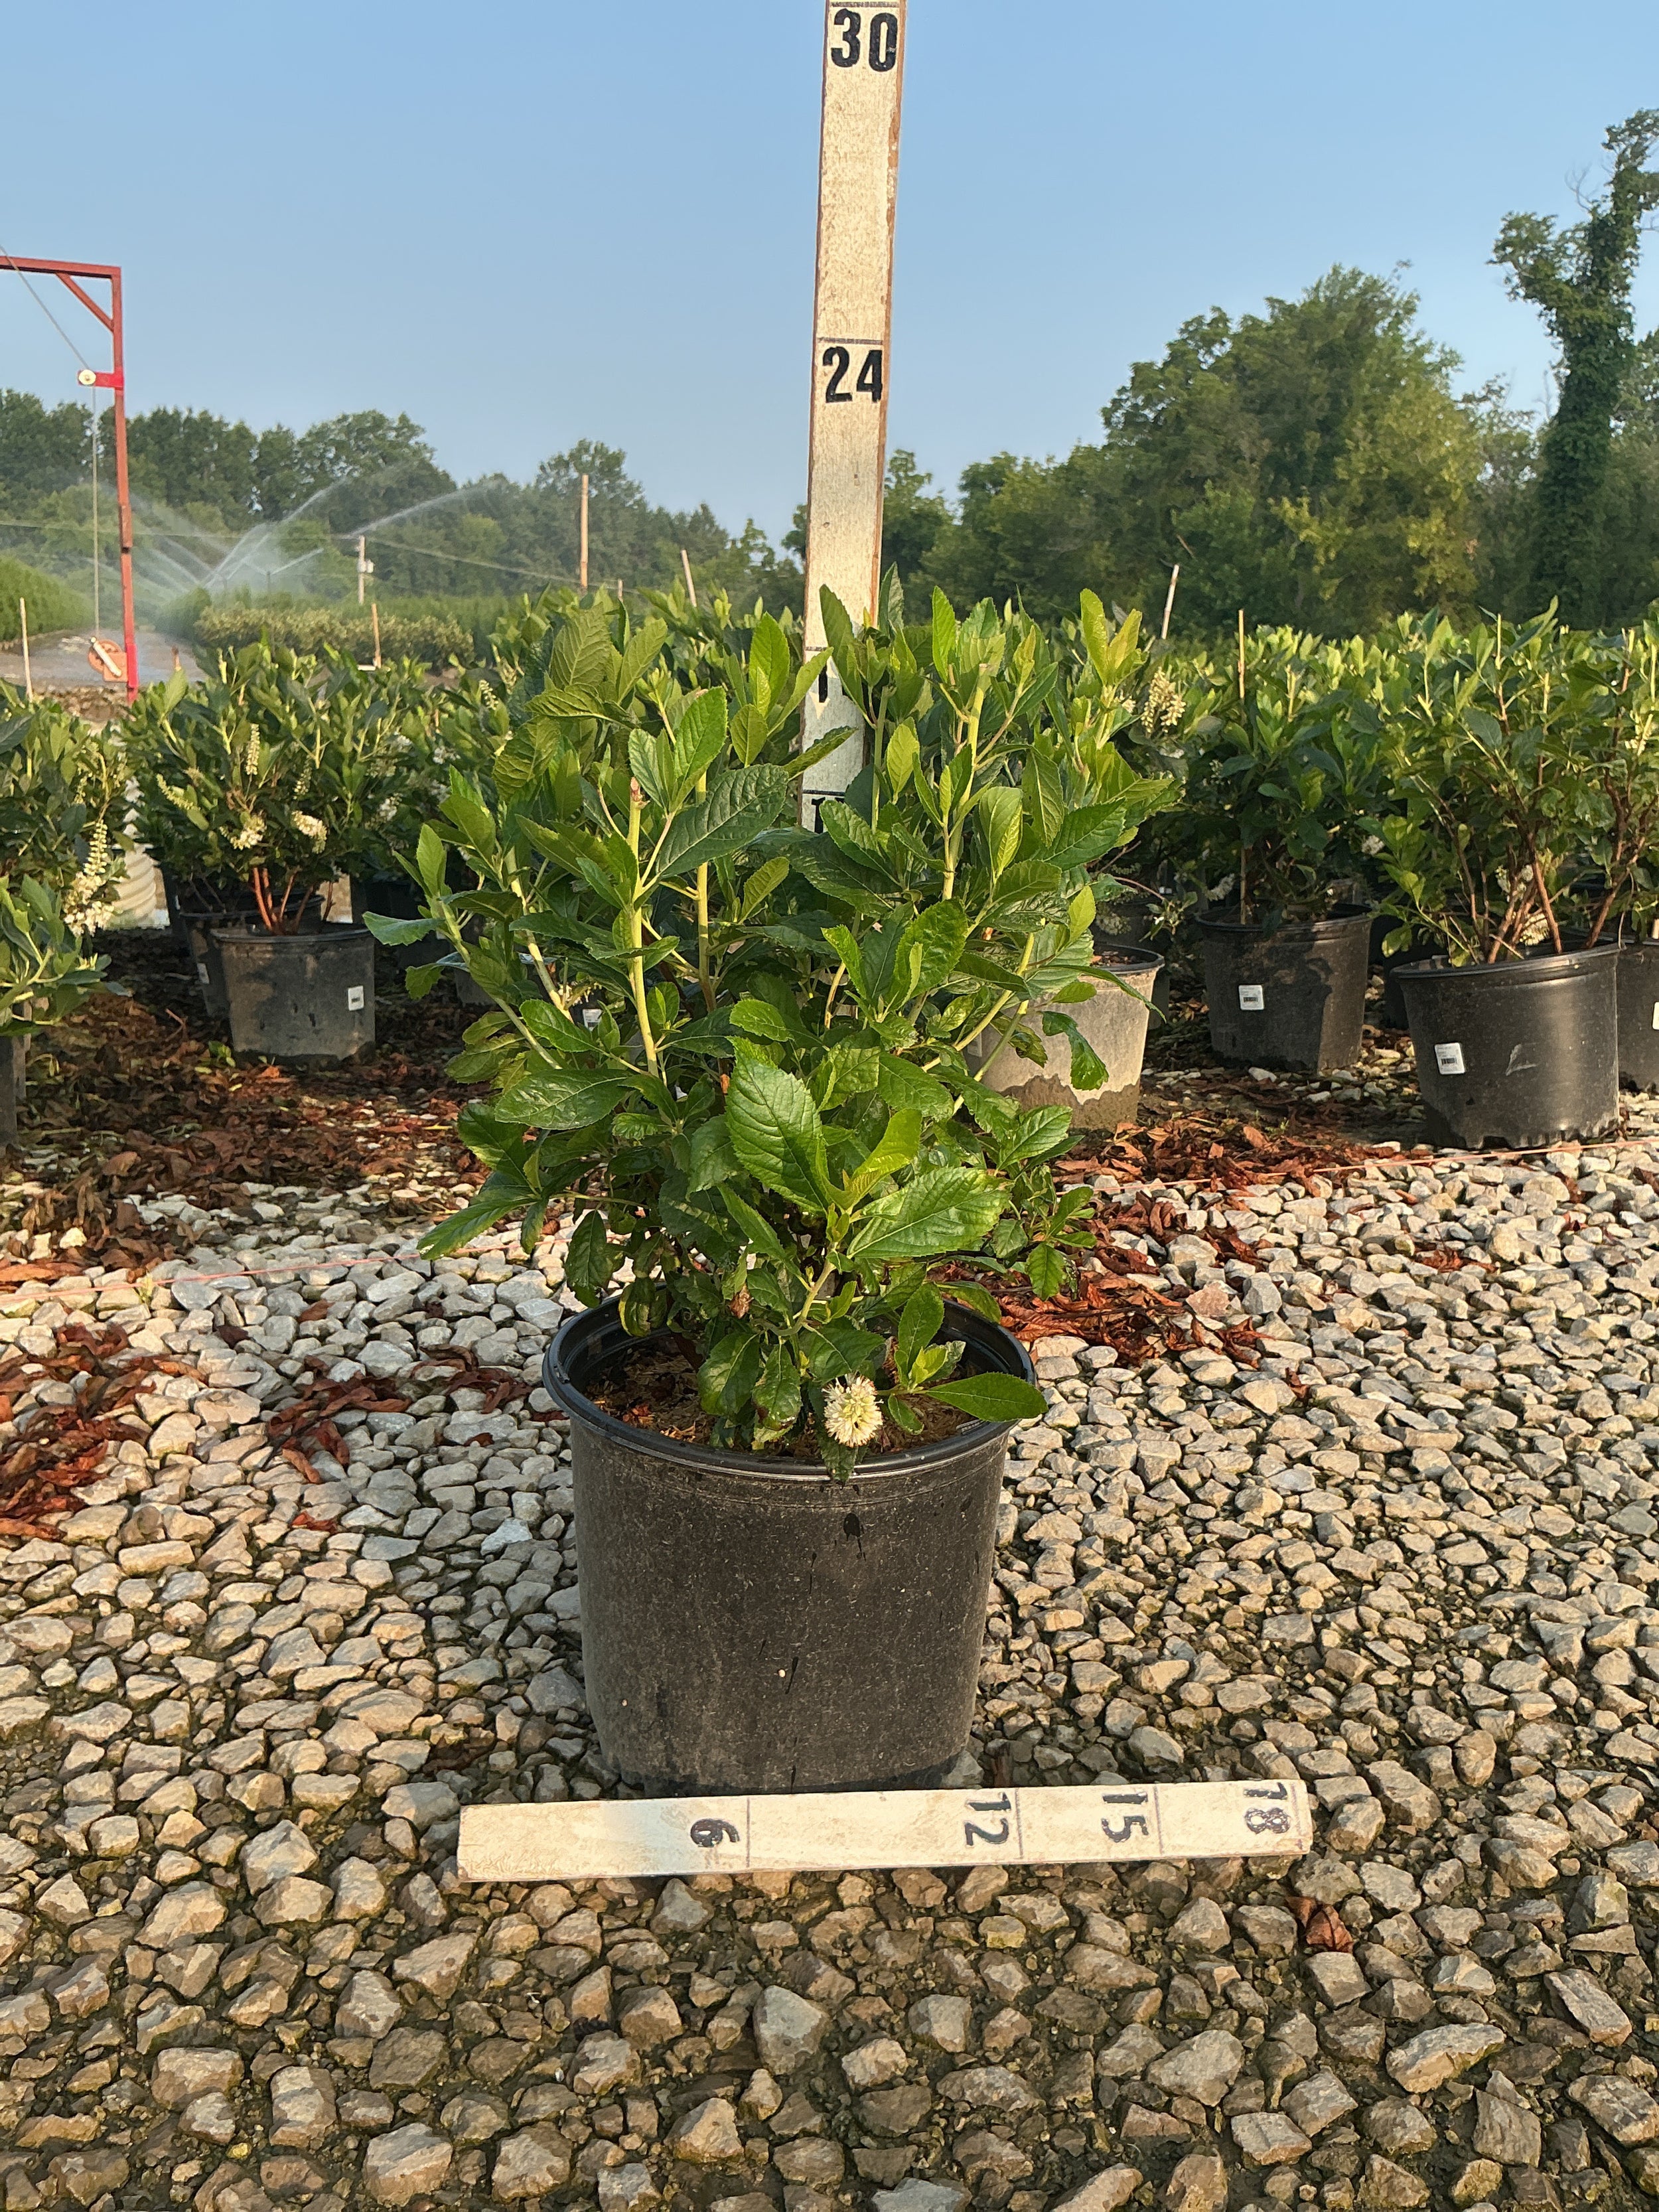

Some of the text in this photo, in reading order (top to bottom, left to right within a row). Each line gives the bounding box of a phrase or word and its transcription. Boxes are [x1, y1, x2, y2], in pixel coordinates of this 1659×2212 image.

[831, 8, 897, 72] 30
[822, 346, 883, 403] 24
[690, 1818, 740, 1848] 6
[965, 1792, 1011, 1846] 12
[1102, 1793, 1149, 1842] 15
[1245, 1782, 1289, 1834] 18
